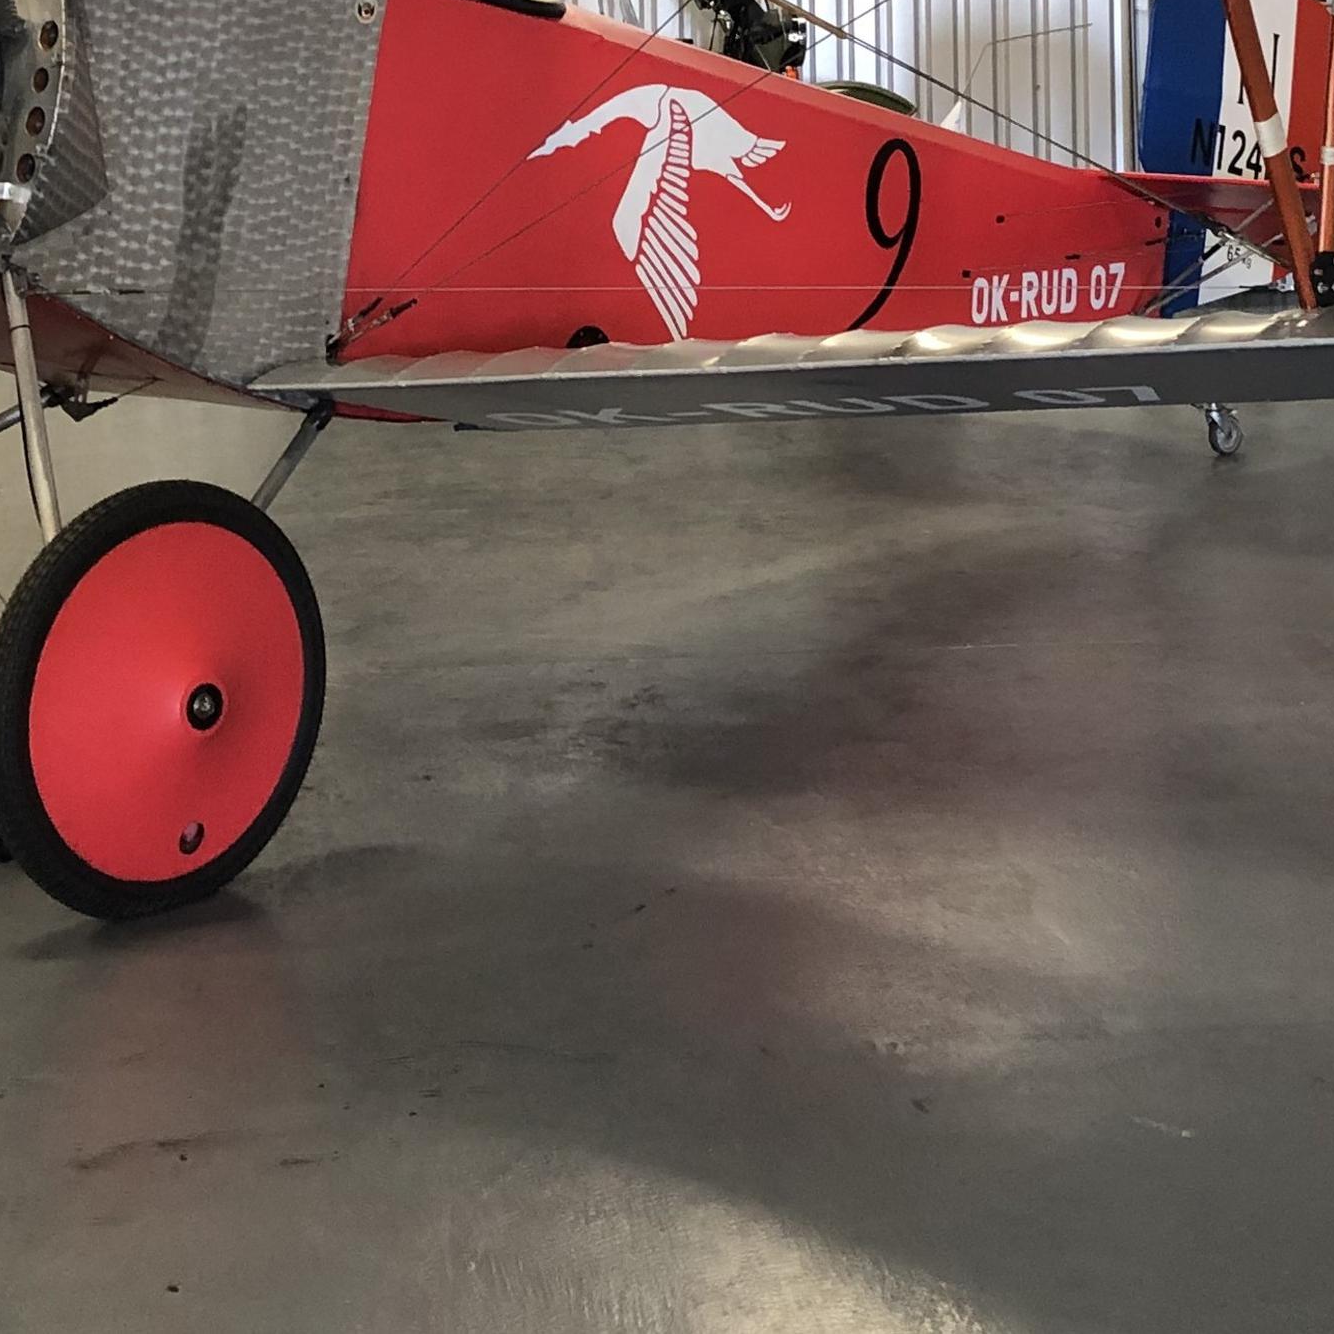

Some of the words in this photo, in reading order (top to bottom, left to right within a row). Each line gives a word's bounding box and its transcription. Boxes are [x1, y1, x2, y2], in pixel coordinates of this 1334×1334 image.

[1190, 118, 1307, 183] N124S
[846, 138, 922, 333] 9
[970, 267, 1078, 325] OK-RUD
[1089, 262, 1126, 310] 07
[485, 394, 991, 427] OK-RUD
[1013, 385, 1162, 405] 07
